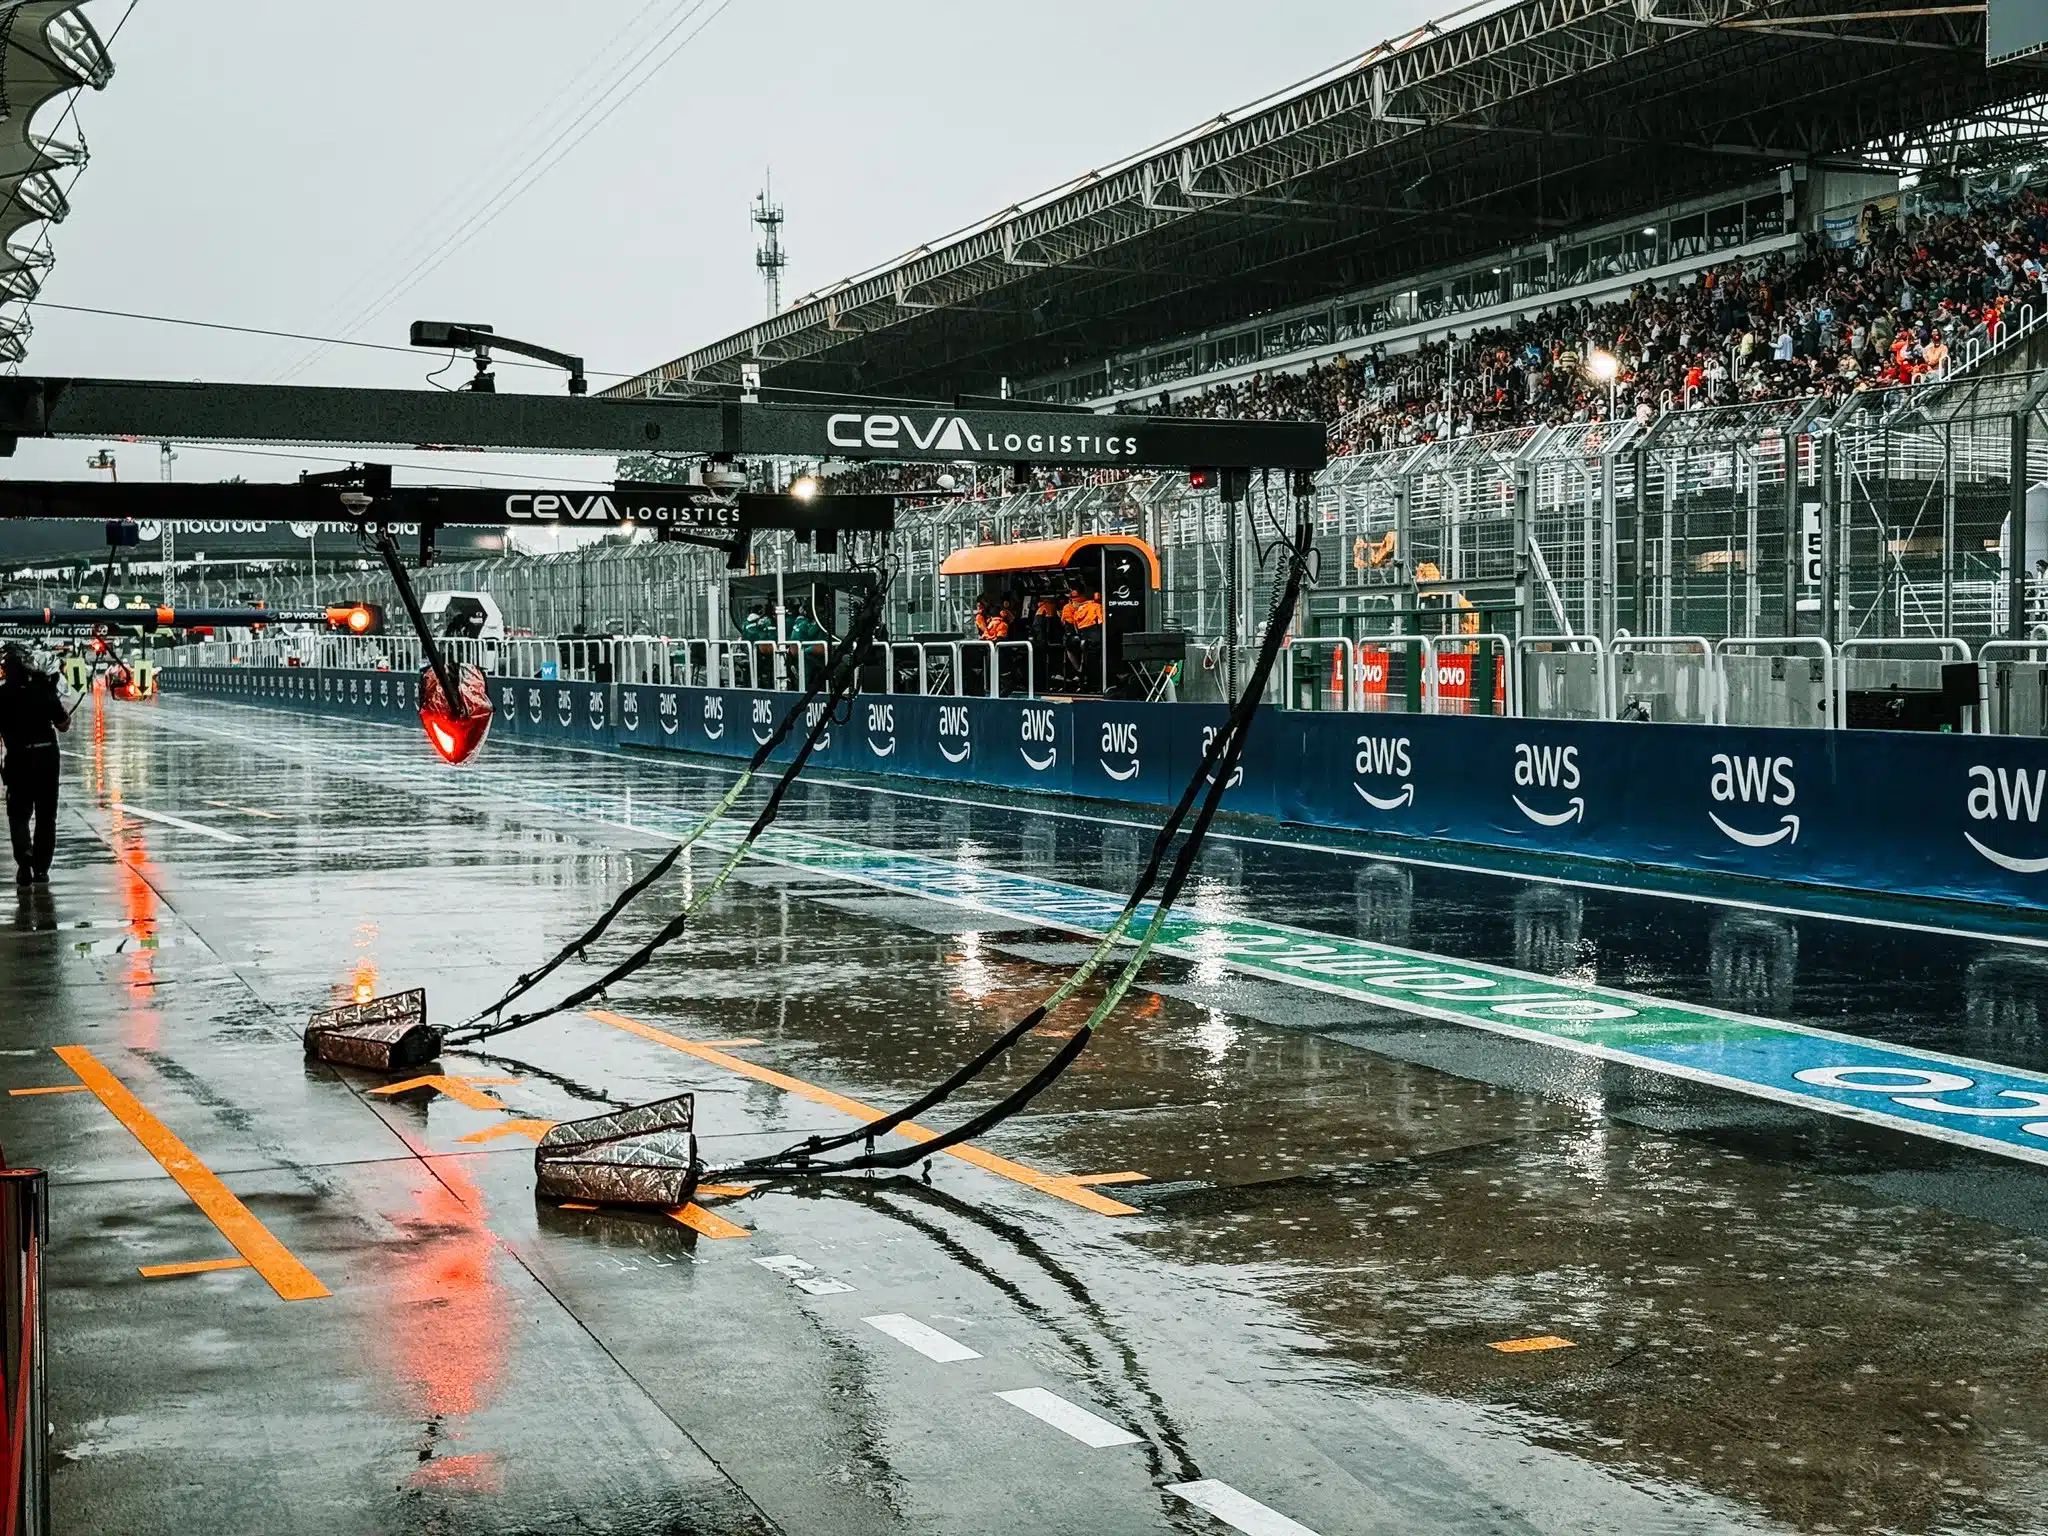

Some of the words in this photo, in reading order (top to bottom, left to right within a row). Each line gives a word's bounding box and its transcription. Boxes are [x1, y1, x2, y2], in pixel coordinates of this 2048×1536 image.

[988, 433, 1137, 455] LOGISTICS
[626, 507, 740, 522] LOGISTICS
[323, 521, 420, 536] mooola
[279, 611, 293, 620] DP
[293, 611, 329, 620] WORLD
[2, 627, 31, 636] ASTON
[660, 693, 678, 716] aws
[705, 696, 723, 720] aws
[753, 698, 772, 725] aws
[869, 704, 894, 732] aws
[940, 706, 970, 737] aws
[1021, 710, 1055, 743] aws
[1101, 723, 1138, 755] aws
[1356, 736, 1412, 777] aws
[1515, 744, 1581, 790] aws
[1711, 754, 1796, 806] aws
